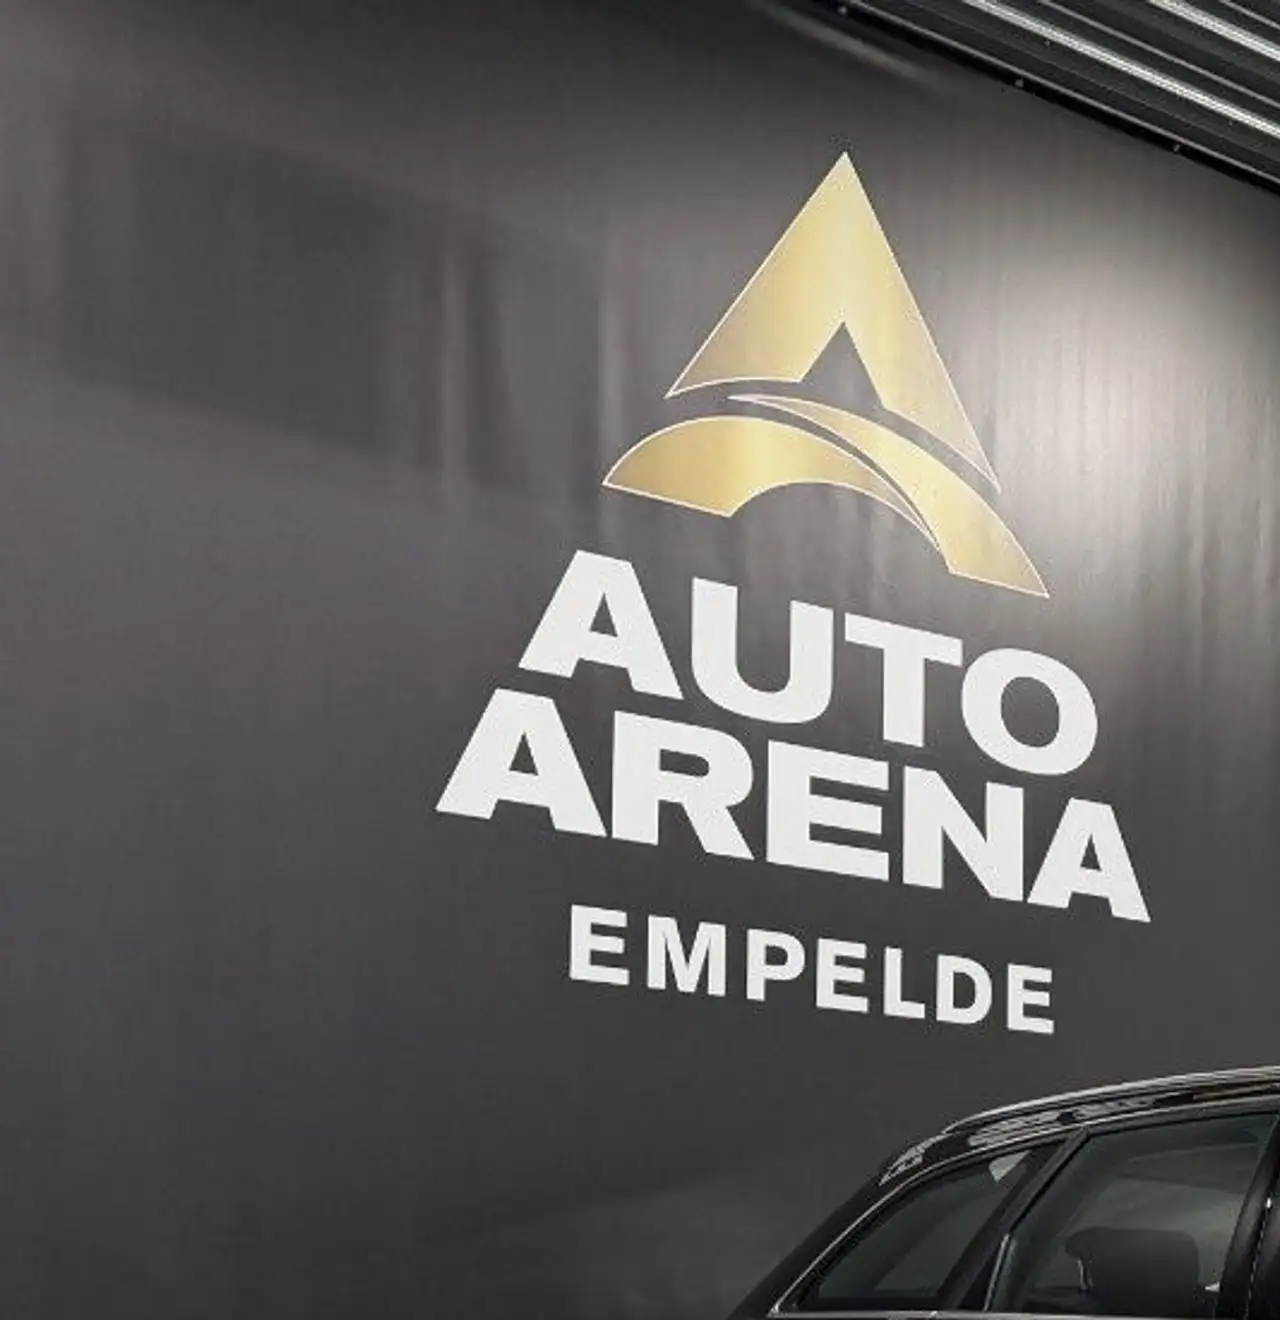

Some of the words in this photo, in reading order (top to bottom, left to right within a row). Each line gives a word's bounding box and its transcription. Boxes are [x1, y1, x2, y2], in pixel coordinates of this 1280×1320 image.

[518, 549, 1098, 776] AUTO
[435, 688, 1151, 923] ARENA
[568, 904, 1055, 1035] EMPELDE
